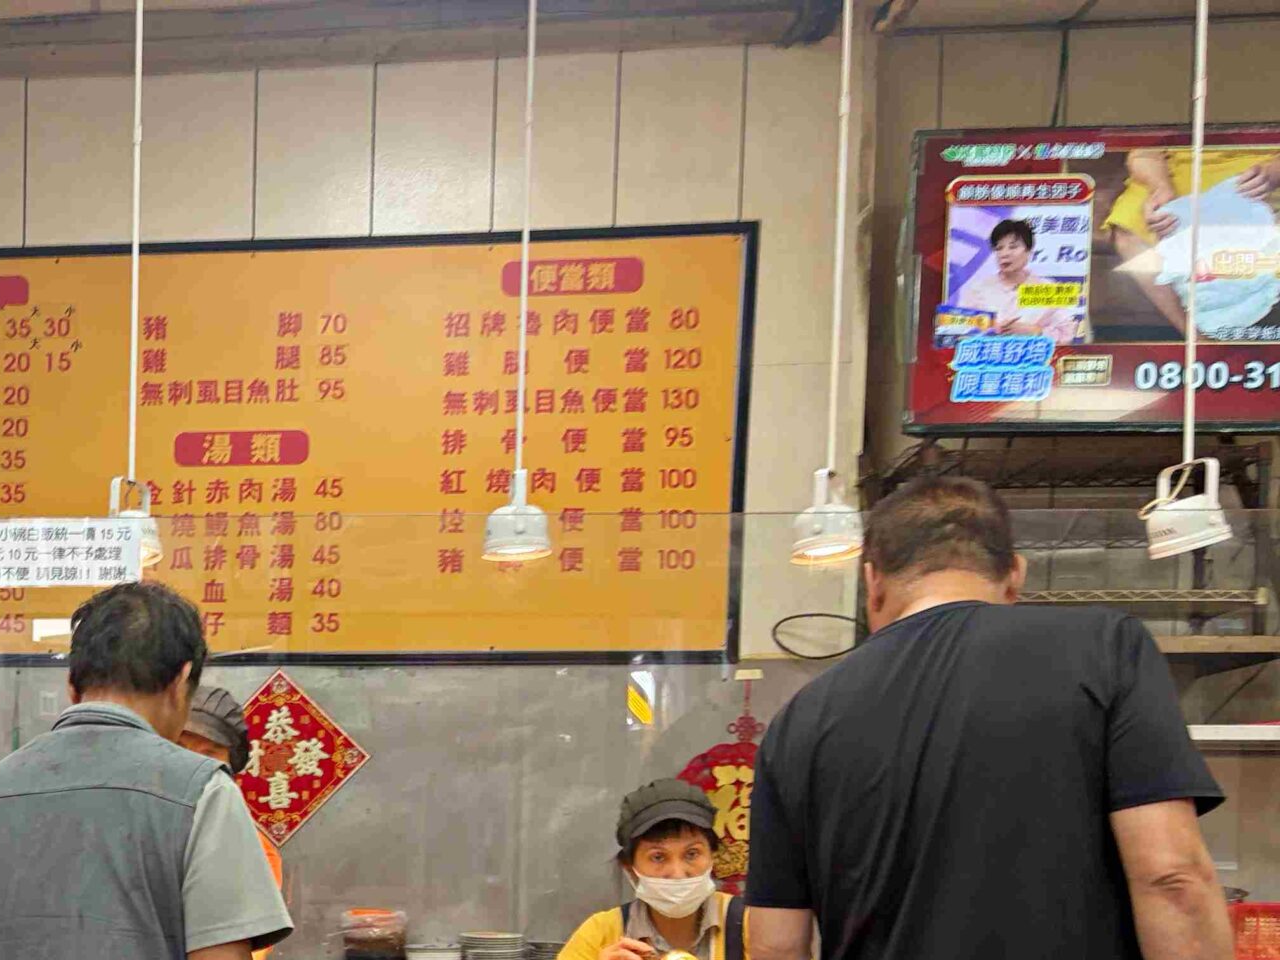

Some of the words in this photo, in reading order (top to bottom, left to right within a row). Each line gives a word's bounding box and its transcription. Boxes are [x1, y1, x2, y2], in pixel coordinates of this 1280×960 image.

[530, 262, 617, 292] 便當類
[6, 318, 31, 338] 35
[43, 317, 70, 337] 30
[320, 313, 347, 334] 70
[669, 308, 699, 329] 80
[3, 352, 30, 372] 20
[45, 351, 71, 373] 15
[141, 345, 301, 373] 雞腿
[319, 345, 346, 366] 85
[664, 347, 701, 369] 120
[318, 379, 344, 399] 95
[958, 371, 1049, 397] 限量福利
[3, 386, 30, 406] 20
[661, 388, 699, 410] 130
[2, 418, 28, 438] 20
[201, 432, 282, 464] 湯類
[441, 427, 647, 455] 排骨便當
[665, 427, 694, 447] 95
[0, 450, 26, 470] 35
[315, 479, 343, 498] 45
[440, 468, 645, 494] 紅燒肉便當
[660, 468, 697, 488] 100
[0, 484, 26, 504] 35
[166, 511, 297, 538] 燒鰻魚湯
[439, 507, 644, 535] 焢便當
[659, 508, 697, 530] 100
[101, 529, 115, 540] 15
[117, 527, 132, 541] 元
[8, 549, 21, 560] 10
[168, 545, 295, 571] 瓜排骨湯
[313, 546, 340, 565] 45
[438, 546, 643, 574] 豬便當
[658, 547, 696, 570] 100
[201, 578, 294, 604] 血湯
[312, 578, 341, 598] 40
[0, 612, 25, 633] 45
[201, 611, 293, 636] 仔麵
[311, 612, 340, 632] 35
